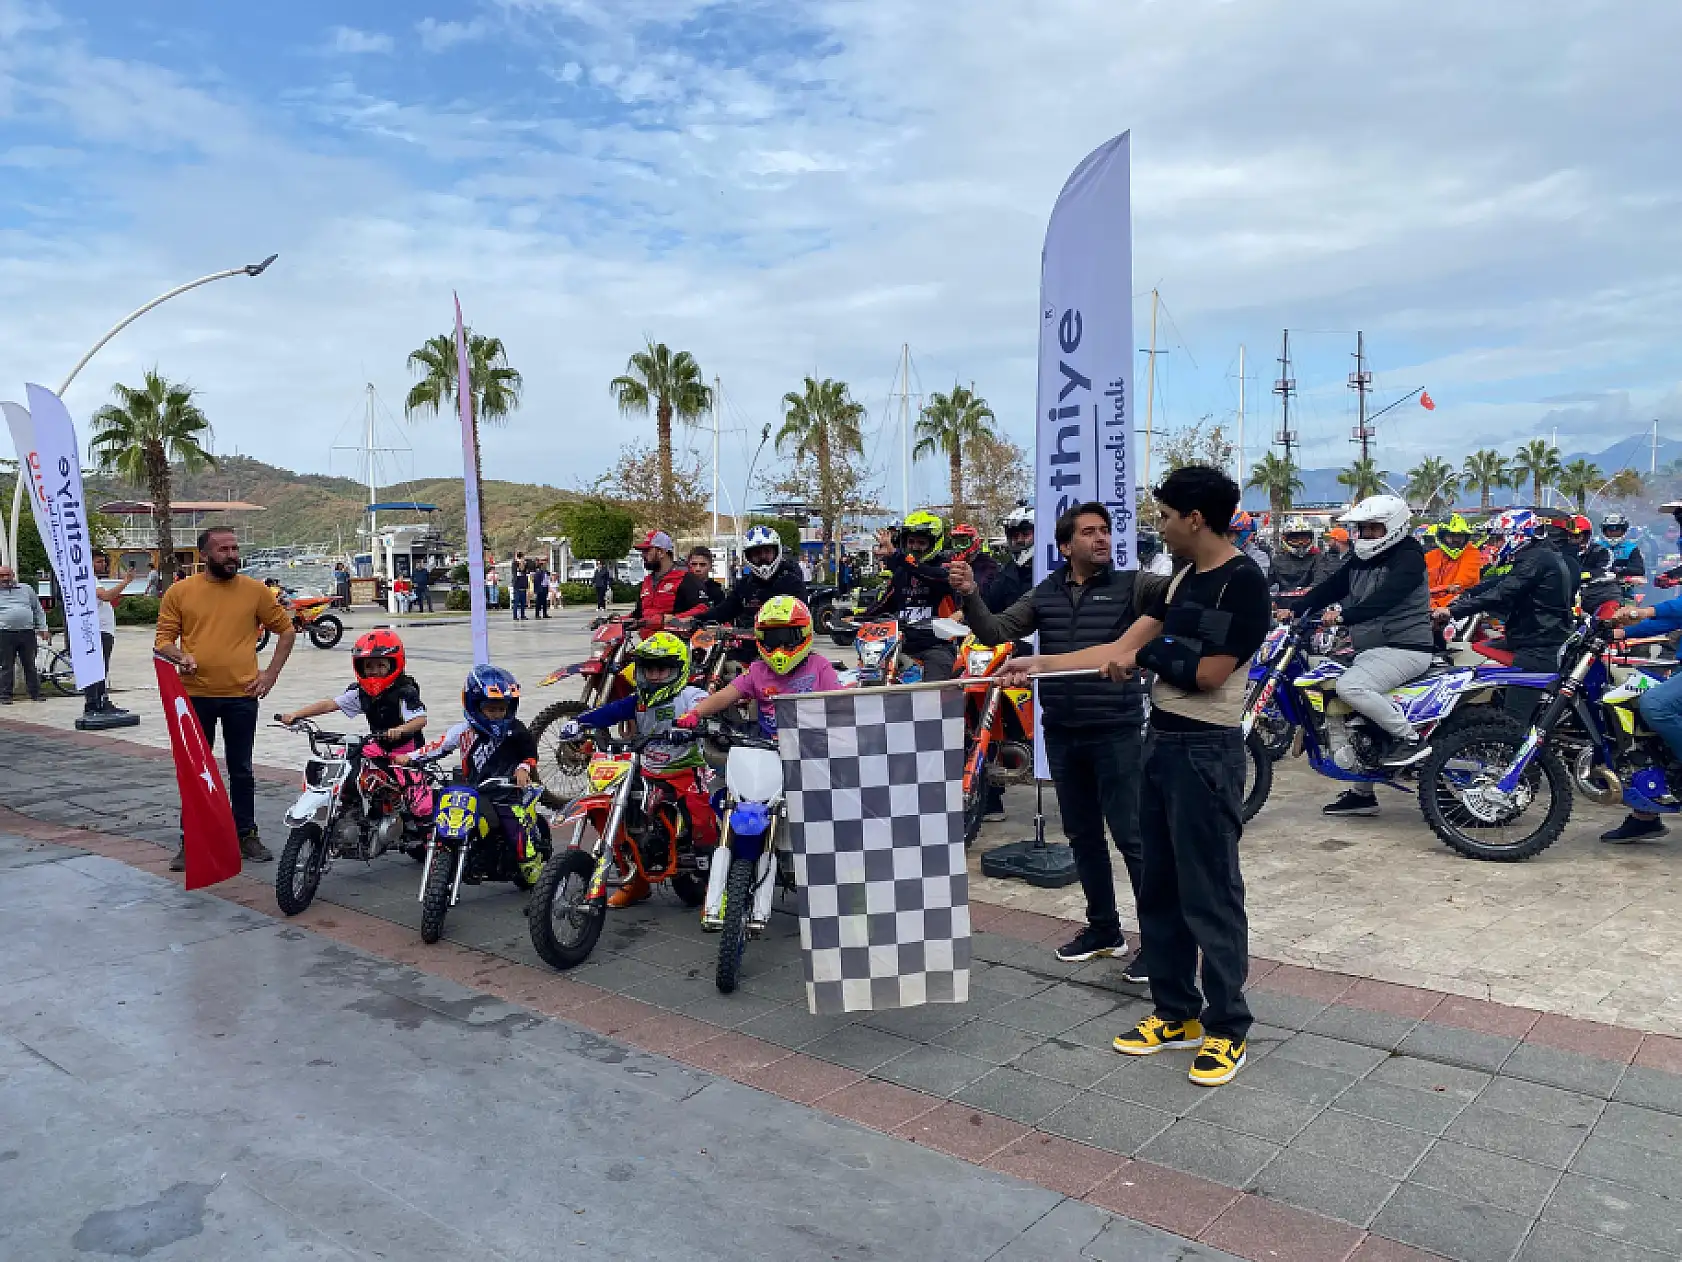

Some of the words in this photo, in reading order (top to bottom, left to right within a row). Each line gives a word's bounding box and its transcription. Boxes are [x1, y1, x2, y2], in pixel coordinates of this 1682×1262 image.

[1047, 308, 1091, 571] Fthiye
[1104, 376, 1125, 428] hali
[1105, 431, 1132, 534] eğlenceli
[1115, 539, 1128, 568] en
